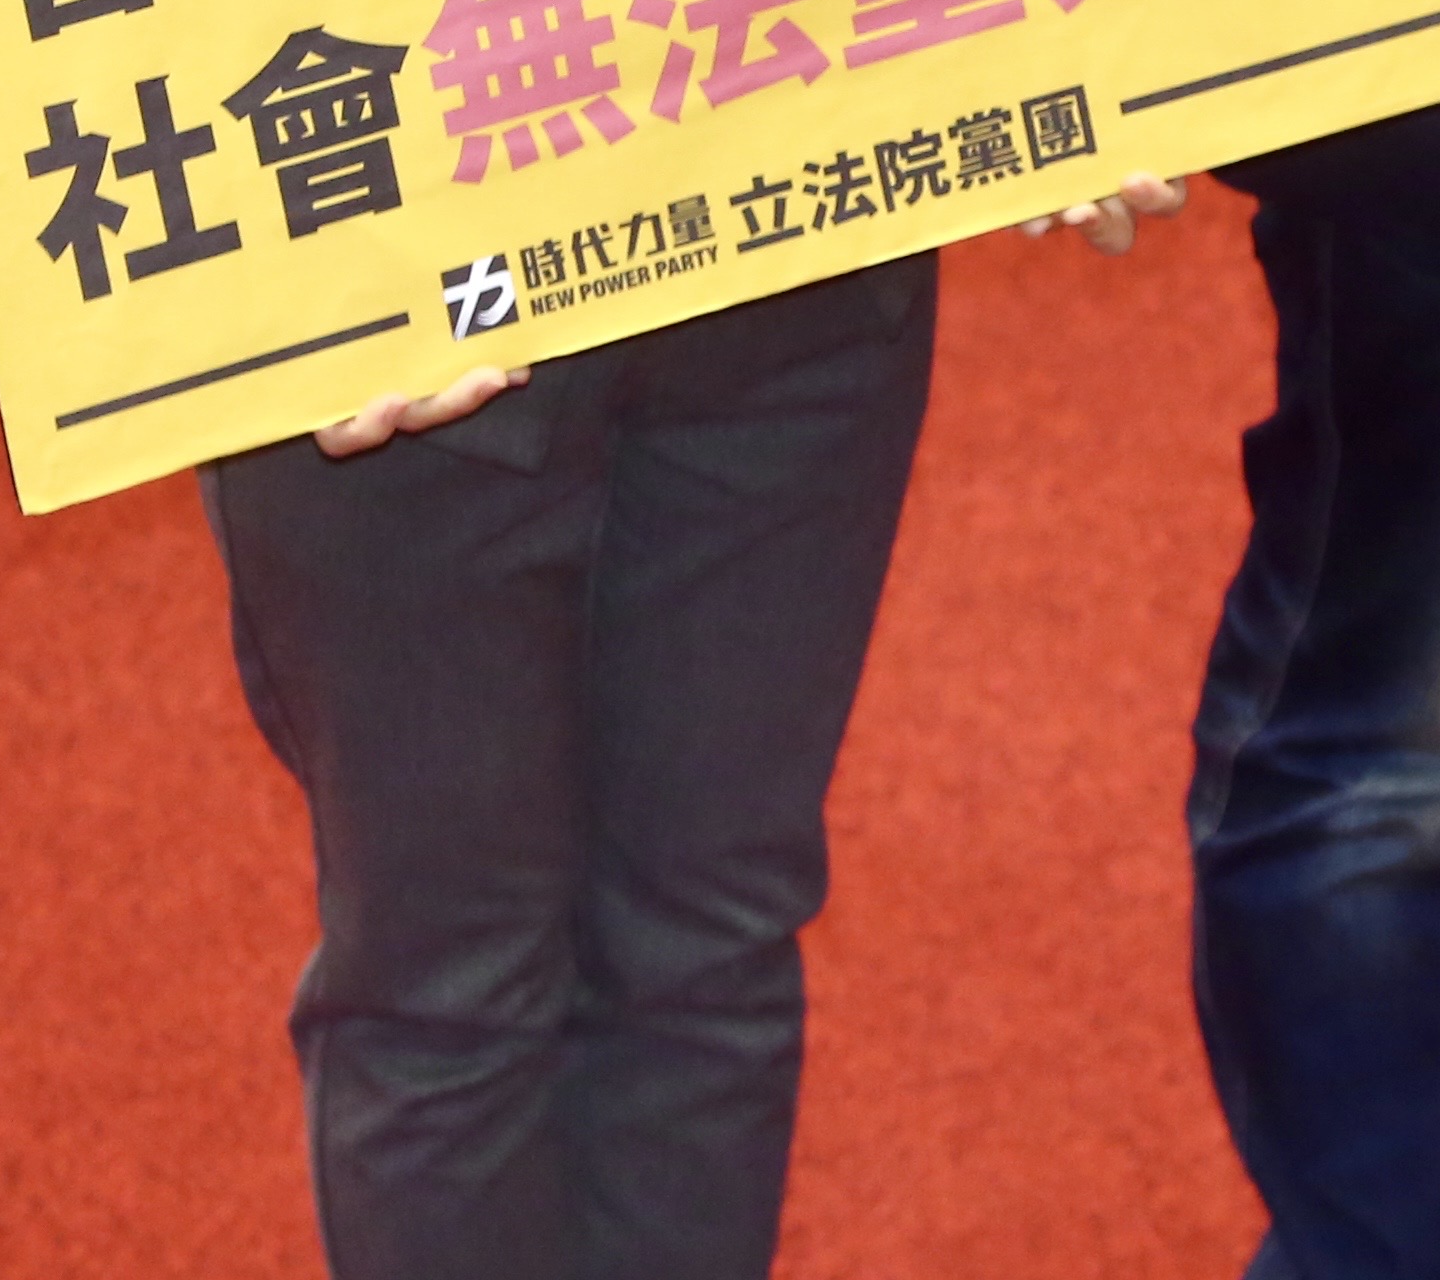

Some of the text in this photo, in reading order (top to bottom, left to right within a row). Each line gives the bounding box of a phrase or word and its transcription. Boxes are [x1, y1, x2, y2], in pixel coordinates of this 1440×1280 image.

[521, 86, 1096, 288] 時代力量 立法院黨團
[531, 247, 717, 316] NEW POWER PARTY
